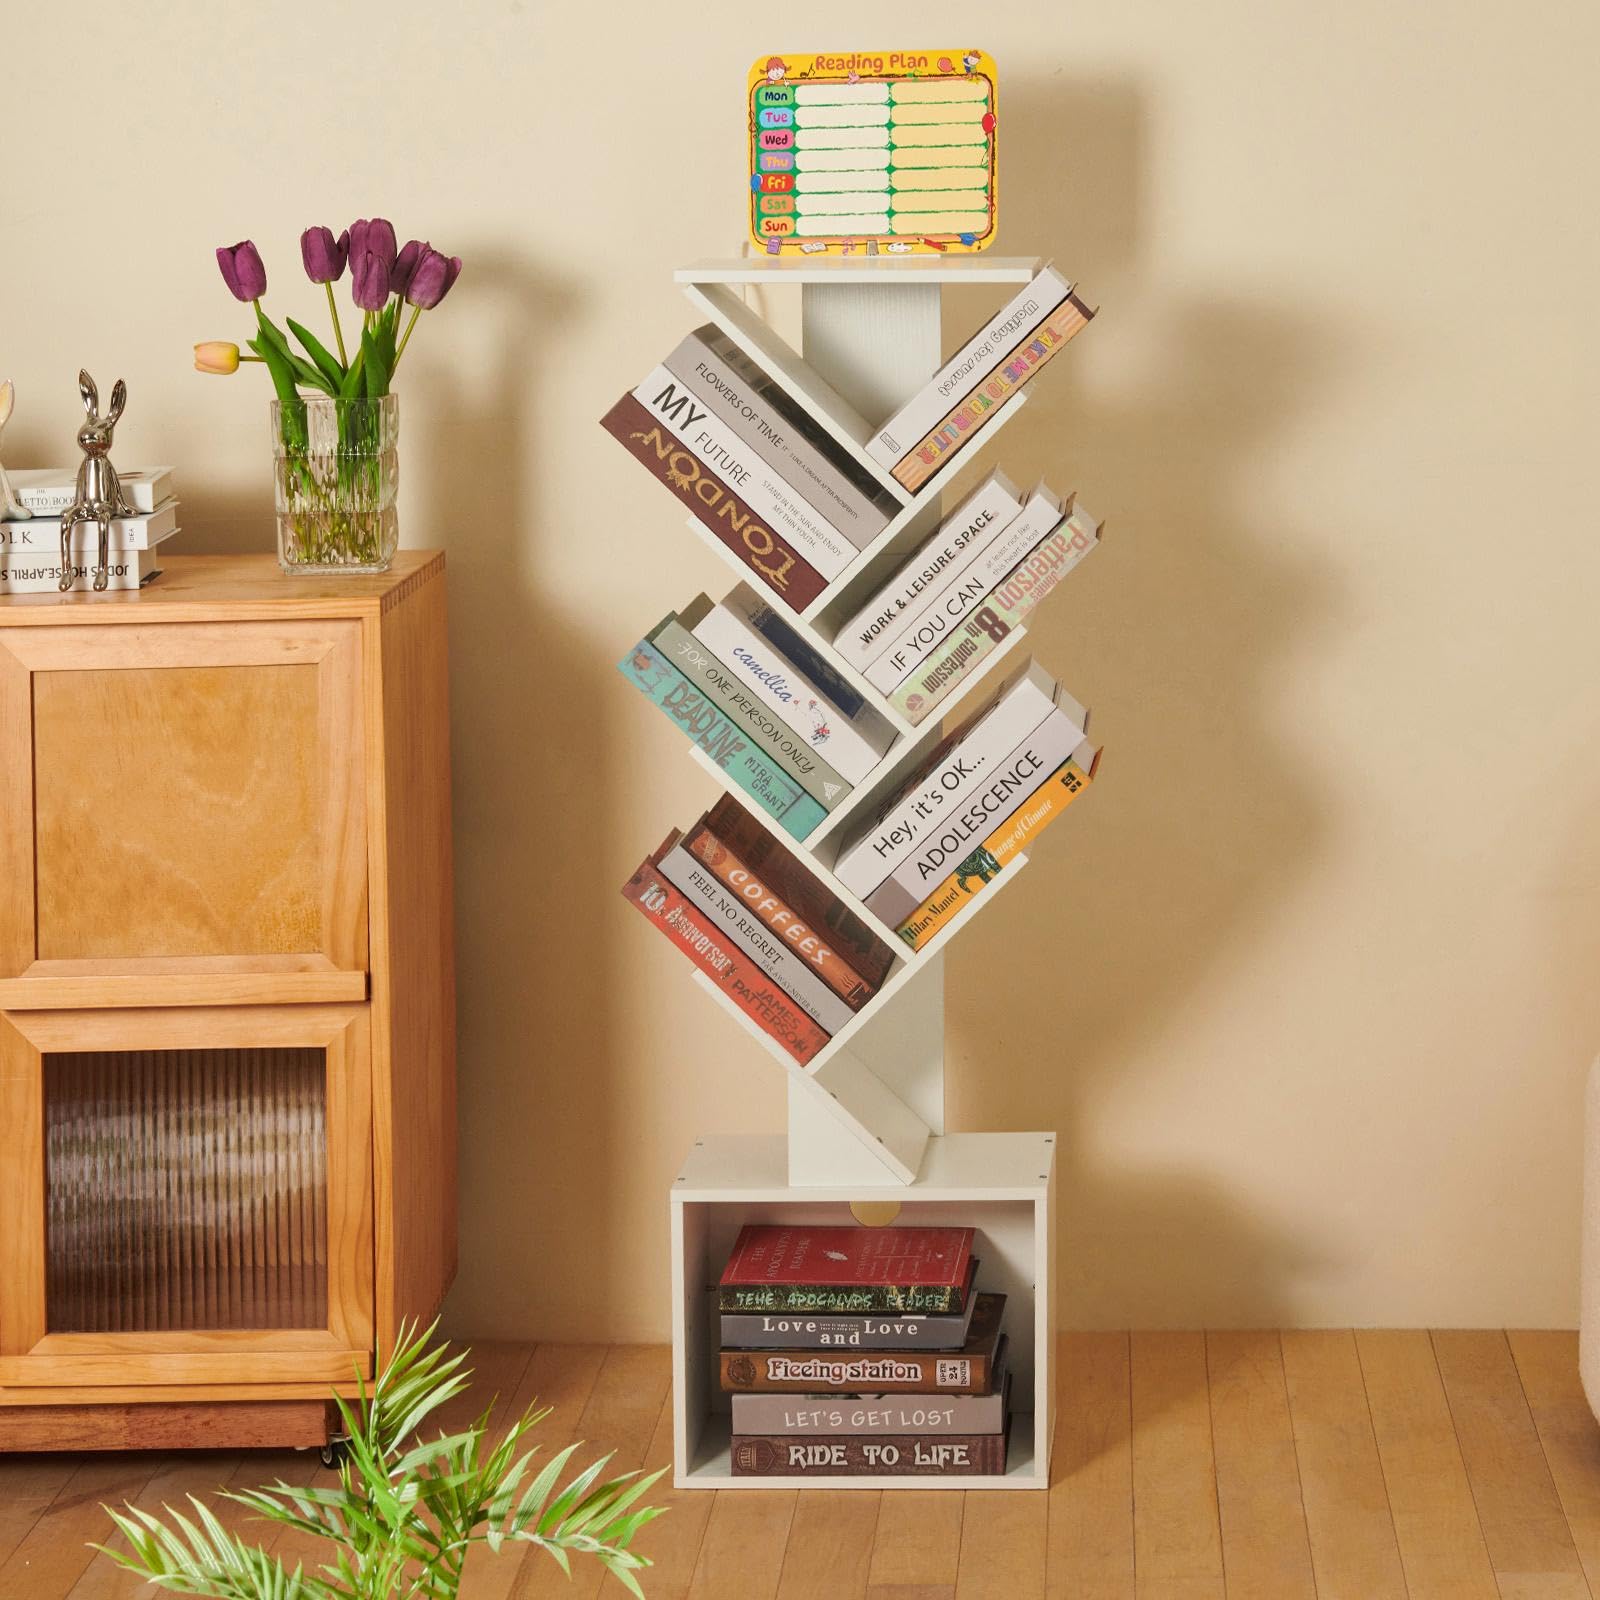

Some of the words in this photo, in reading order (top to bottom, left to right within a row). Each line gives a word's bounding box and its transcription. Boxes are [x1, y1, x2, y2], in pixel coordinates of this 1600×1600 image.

[815, 53, 884, 72] Reading
[889, 53, 928, 69] Plan
[765, 90, 788, 102] Mon
[765, 112, 788, 123] Tue
[765, 134, 788, 146] Wed
[765, 156, 789, 168] Thu
[767, 176, 786, 189] Fri
[767, 199, 787, 210] Sat
[765, 220, 788, 232] Sun
[990, 299, 1039, 343] Waiting
[976, 341, 994, 362] for
[1022, 326, 1062, 364] TAKE
[937, 358, 974, 396] sunset
[1002, 356, 1030, 384] ME
[985, 376, 1010, 399] TO
[695, 362, 744, 410] FLOWERS
[739, 404, 760, 422] OF
[757, 419, 783, 448] TIME
[953, 393, 994, 431] YOUR
[652, 383, 707, 432] MY
[694, 431, 752, 488] FUTURE
[917, 425, 960, 464] LITER
[52, 495, 77, 507] BOO
[629, 426, 797, 592] LONDON
[760, 479, 782, 500] STAND
[786, 503, 800, 518] THE
[796, 513, 813, 529] SUN
[809, 525, 825, 541] AND
[820, 537, 842, 557] ENJOY
[772, 504, 783, 516] MY
[997, 519, 1090, 612] Patterson
[1002, 545, 1022, 564] heart
[11, 566, 87, 579] HOSE.APRIL
[859, 607, 897, 644] WORK
[895, 598, 907, 610] &
[905, 547, 956, 599] LEISURE
[954, 509, 994, 549] SPACE
[889, 651, 909, 672] IF
[907, 614, 946, 653] YOU
[945, 576, 985, 616] CAN
[733, 646, 795, 703] camellia
[921, 639, 980, 694] confession
[661, 679, 748, 770] DEADLINE
[705, 668, 734, 696] ONE
[729, 693, 786, 743] PERSON
[779, 740, 815, 774] ONLY
[744, 755, 773, 786] MIRA
[751, 778, 787, 812] GRANT
[872, 818, 918, 858] Hey,
[911, 791, 944, 821] it's
[940, 755, 985, 791] OK...
[915, 749, 1044, 880] ADOLESCENCE
[1019, 798, 1053, 832] Climate
[1013, 822, 1027, 842] of
[688, 870, 717, 902] FEEL
[715, 898, 737, 920] NO
[735, 913, 784, 965] REGRET
[727, 869, 831, 966] COFFEES
[904, 912, 936, 943] Hilary
[926, 886, 961, 919] Mantel
[731, 978, 808, 1053] PATTERSON
[754, 987, 799, 1030] JAMES
[763, 1317, 817, 1333] Love
[864, 1321, 918, 1336] Love
[820, 1331, 860, 1345] and
[948, 1366, 958, 1380] 24
[784, 1411, 843, 1428] LET'S
[851, 1410, 892, 1426] GET
[900, 1409, 955, 1425] LOST
[789, 1444, 848, 1469] RIDE
[863, 1444, 900, 1466] TO
[914, 1442, 970, 1469] LIFE
